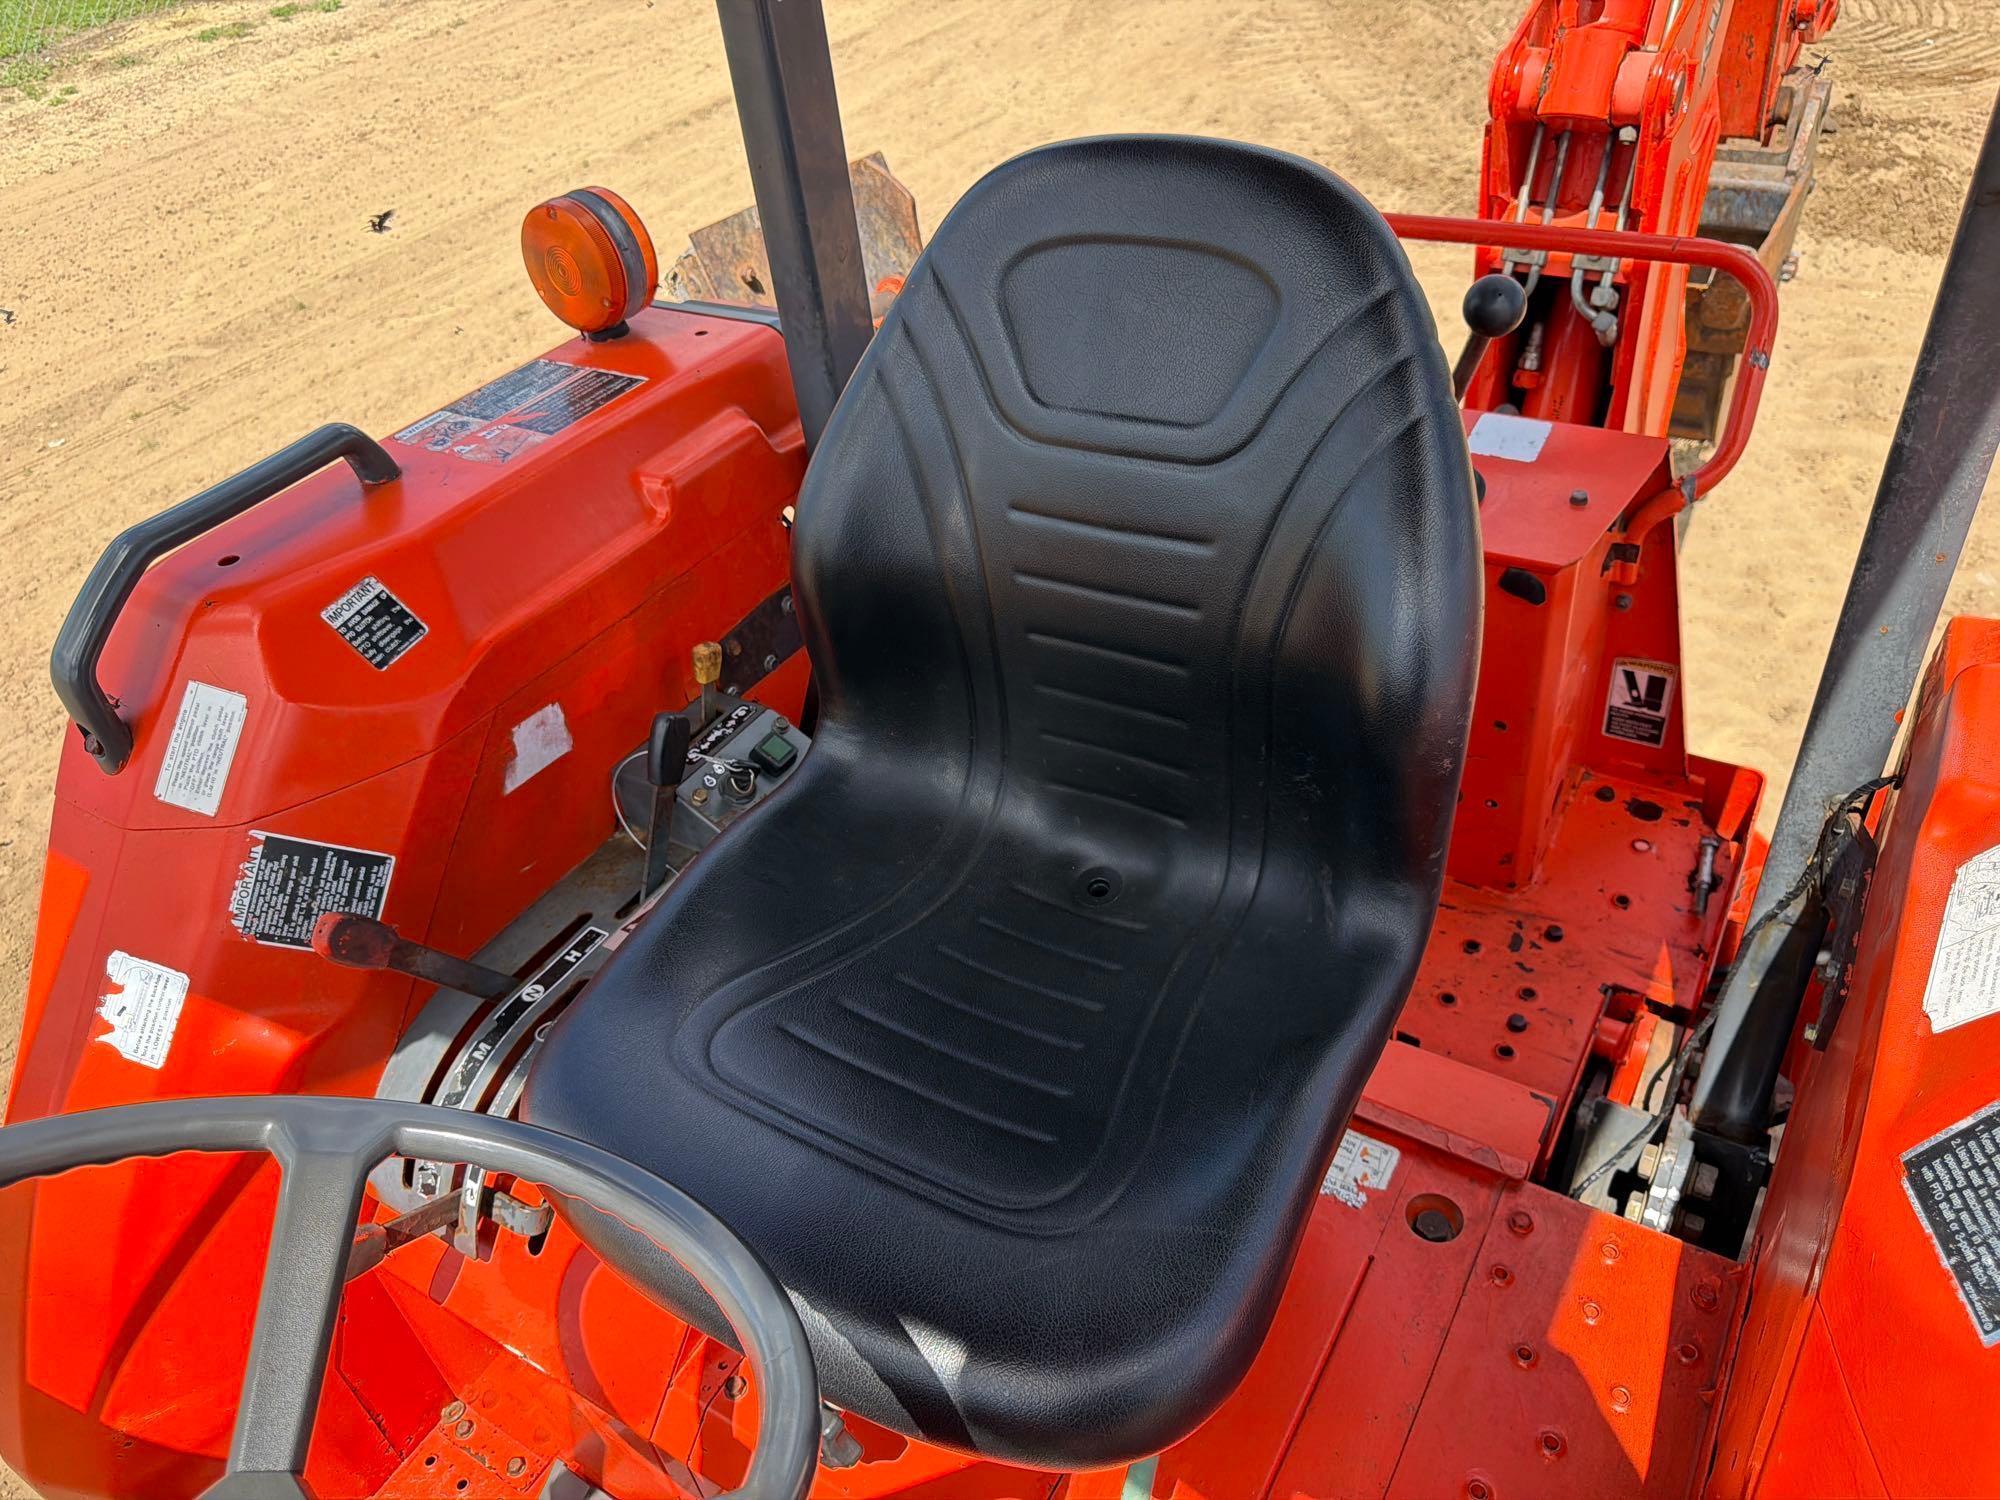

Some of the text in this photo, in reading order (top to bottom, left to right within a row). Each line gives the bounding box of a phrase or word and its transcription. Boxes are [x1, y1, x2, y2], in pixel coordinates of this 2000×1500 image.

[326, 582, 376, 623] IMPORTANT
[348, 615, 361, 627] AVOID
[178, 709, 187, 730] engine
[565, 951, 581, 962] H
[134, 1036, 143, 1054] Before
[140, 1009, 151, 1034] attaching
[472, 1042, 492, 1061] M
[1968, 1141, 1999, 1188] except when
[1980, 1133, 1995, 1154] Keep
[1951, 1138, 1961, 1148] 2.
[1956, 1146, 1972, 1169] Using
[1968, 1170, 1983, 1187] seat
[1978, 1187, 1988, 1197] in
[1932, 1159, 1953, 1191] backhoe
[1949, 1193, 1963, 1209] may
[1959, 1211, 1978, 1233] result
[1972, 1234, 1982, 1244] in
[1944, 1154, 1966, 1187] operating
[1963, 1189, 1992, 1235] attachments
[1921, 1166, 1987, 1286] with PTO shaft or 3-point hitch.
